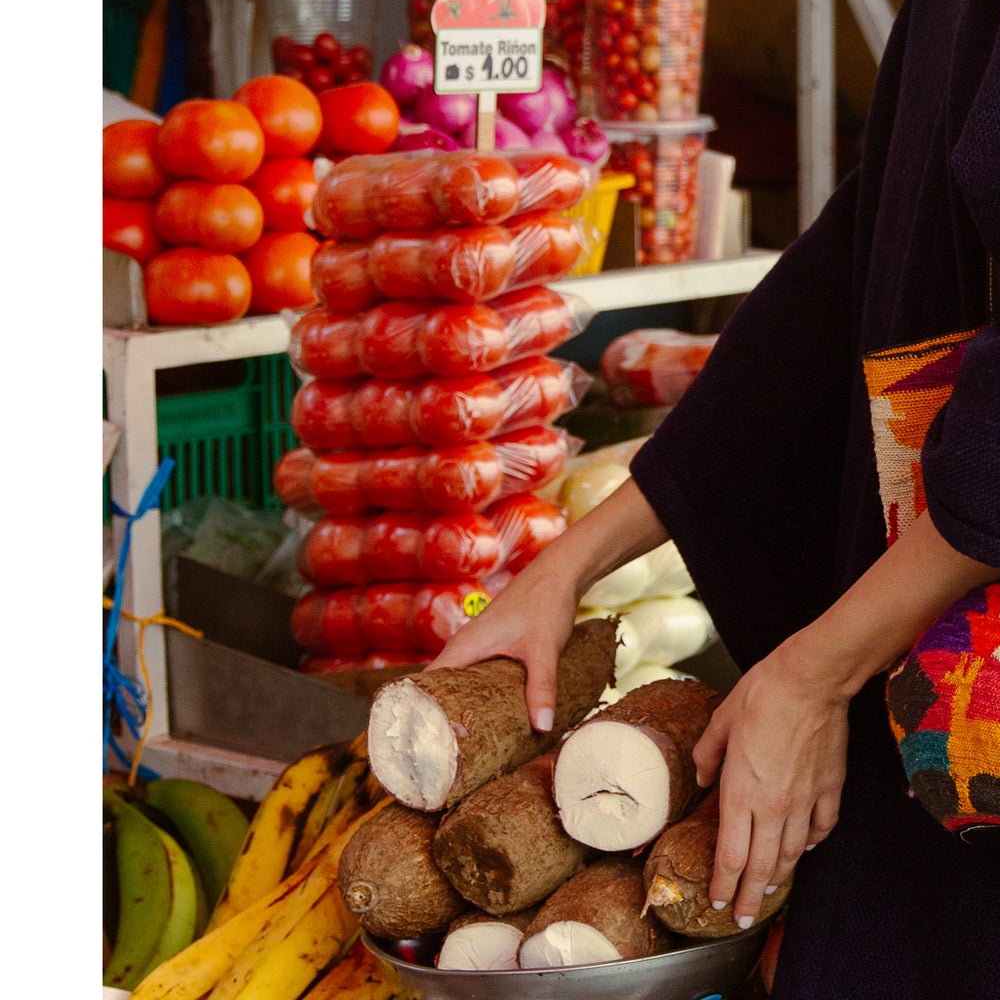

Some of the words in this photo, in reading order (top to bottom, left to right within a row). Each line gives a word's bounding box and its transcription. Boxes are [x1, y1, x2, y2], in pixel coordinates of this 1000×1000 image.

[441, 41, 492, 56] Tomate
[465, 65, 474, 80] $
[482, 53, 528, 80] 1.00
